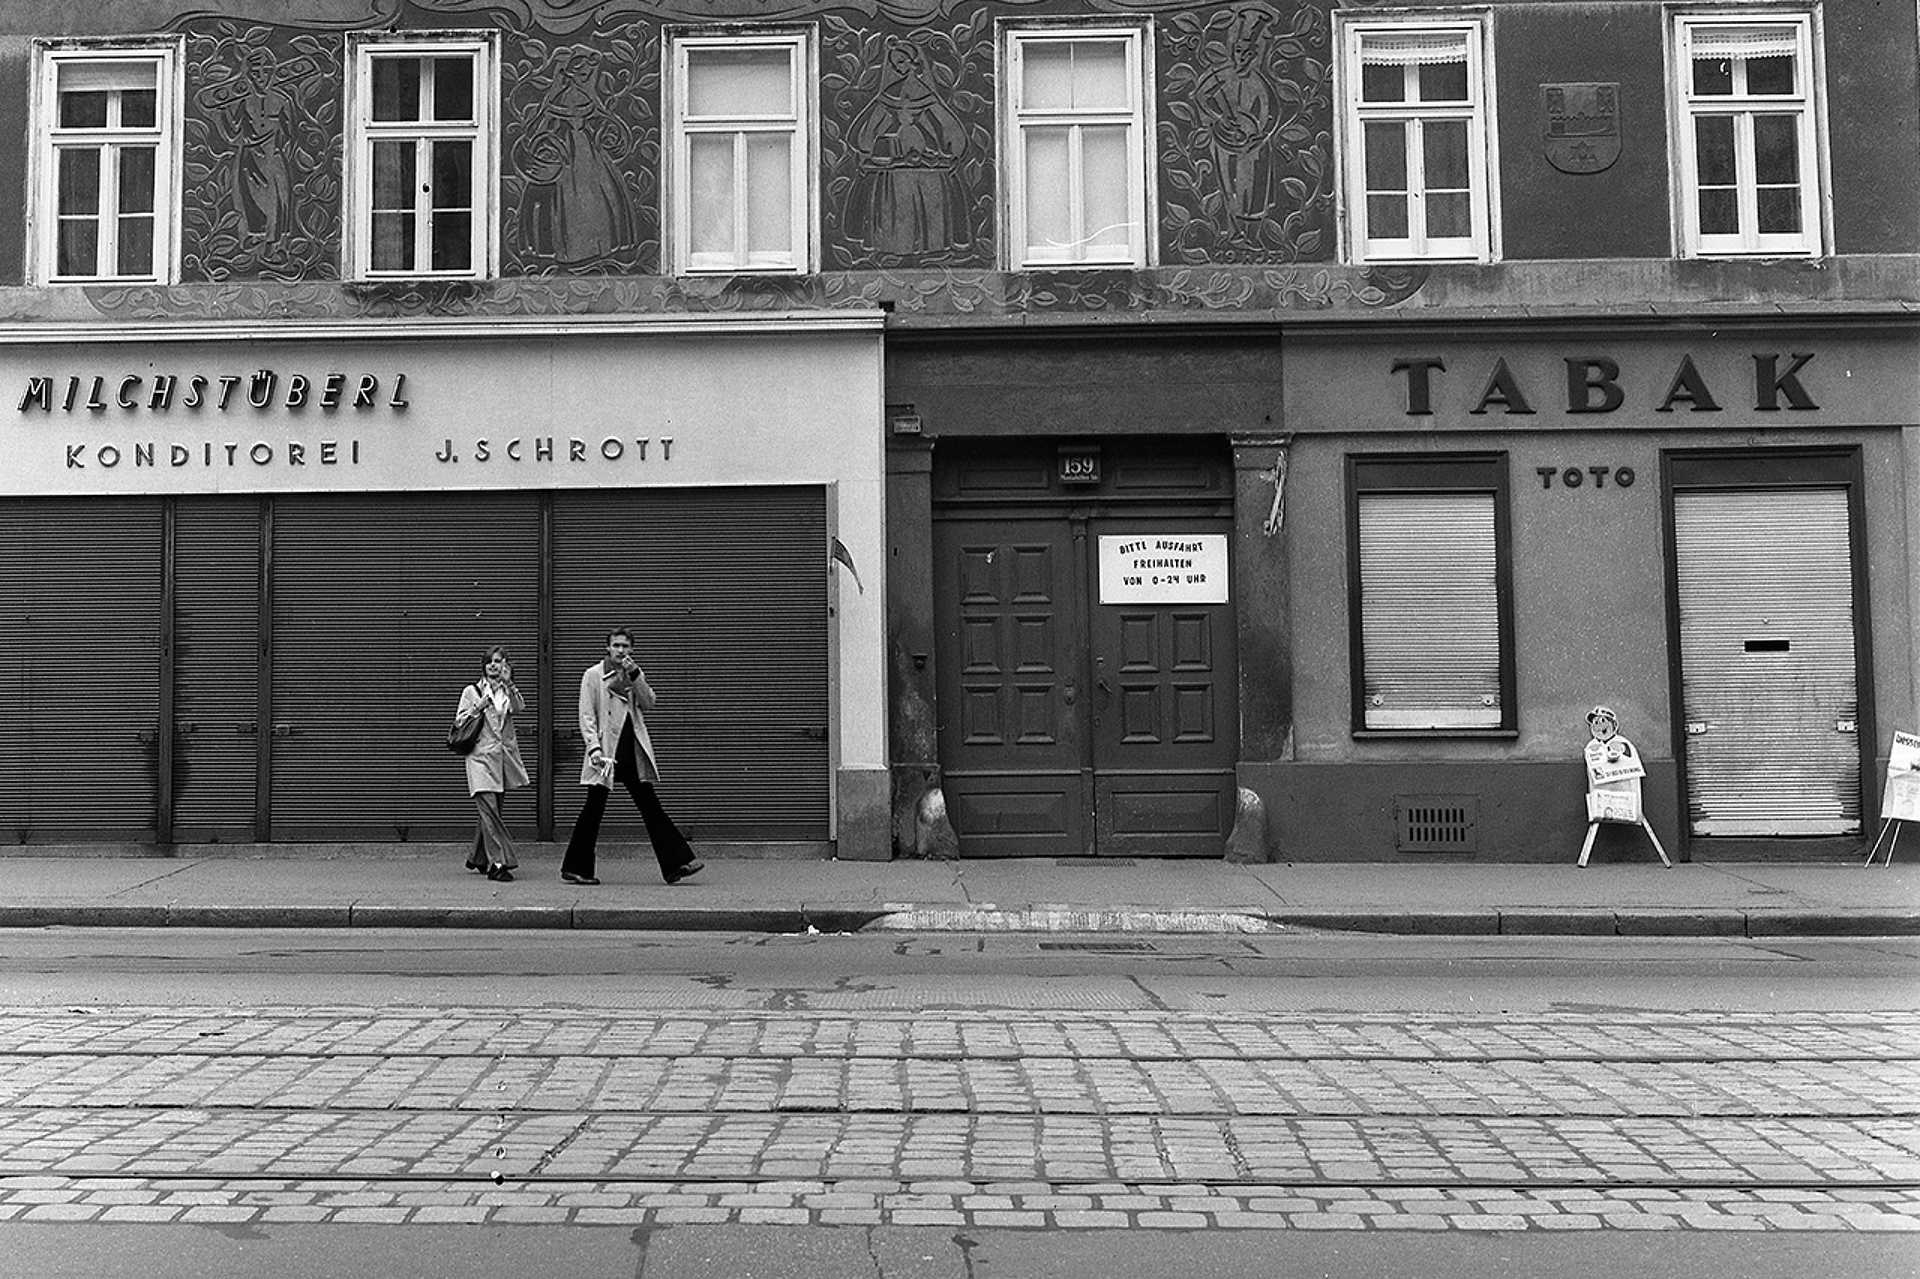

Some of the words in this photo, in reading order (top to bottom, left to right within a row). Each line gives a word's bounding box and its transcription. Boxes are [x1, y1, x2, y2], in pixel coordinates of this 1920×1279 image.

[19, 370, 410, 412] MILCHSTÜBERL
[1390, 353, 1820, 414] TABAK
[66, 439, 362, 468] KONDITOREI
[436, 438, 459, 464] J.
[474, 435, 676, 463] SCHROTT
[1065, 457, 1094, 474] 159
[1536, 466, 1636, 489] TOTO
[1119, 541, 1147, 555] BITTE
[1155, 540, 1204, 552] AUSFAHRT
[1133, 559, 1193, 569] FREIHALTEN
[1123, 576, 1143, 586] VON
[1152, 575, 1180, 586] 0-24
[1186, 573, 1207, 584] UHR
